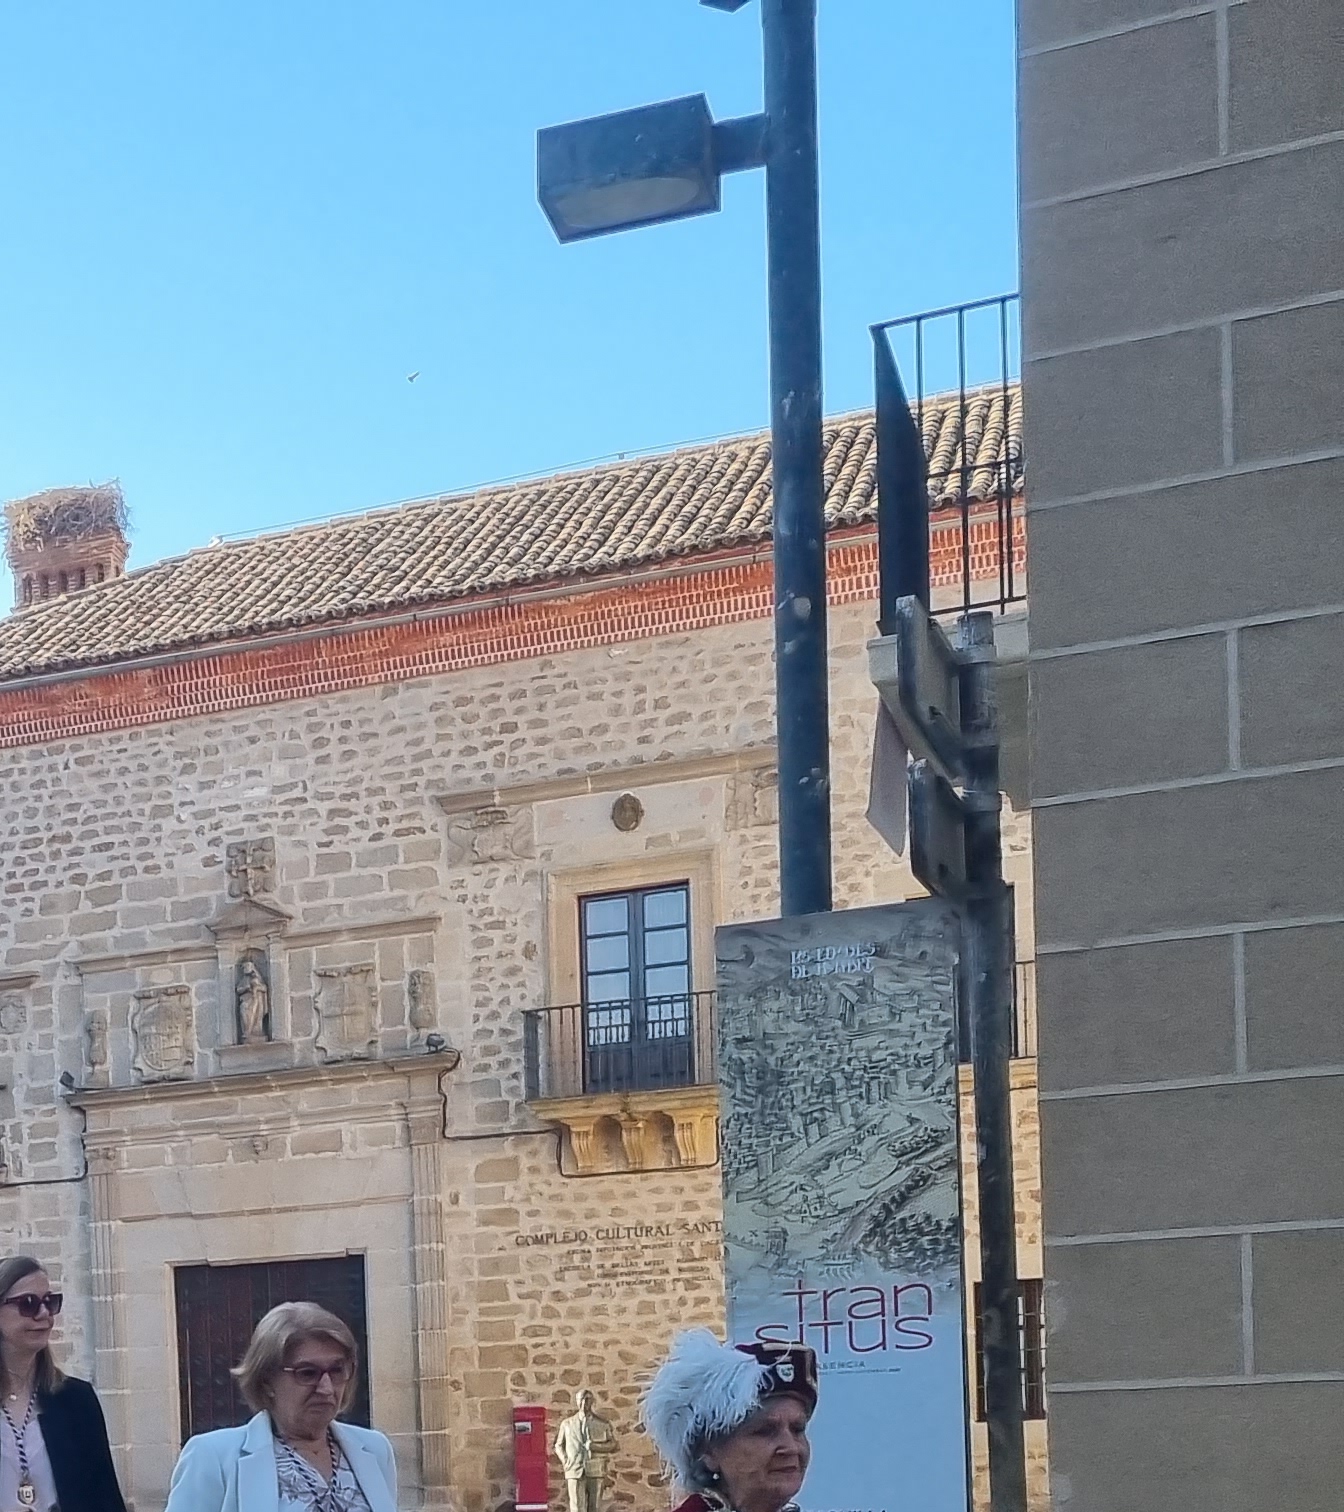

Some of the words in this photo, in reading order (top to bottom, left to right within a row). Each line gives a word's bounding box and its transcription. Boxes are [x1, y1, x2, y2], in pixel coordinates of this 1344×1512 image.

[515, 1229, 588, 1246] COMPLEJO
[596, 1223, 675, 1241] CULTURAL
[681, 1219, 723, 1234] SANT
[783, 1279, 933, 1323] tran
